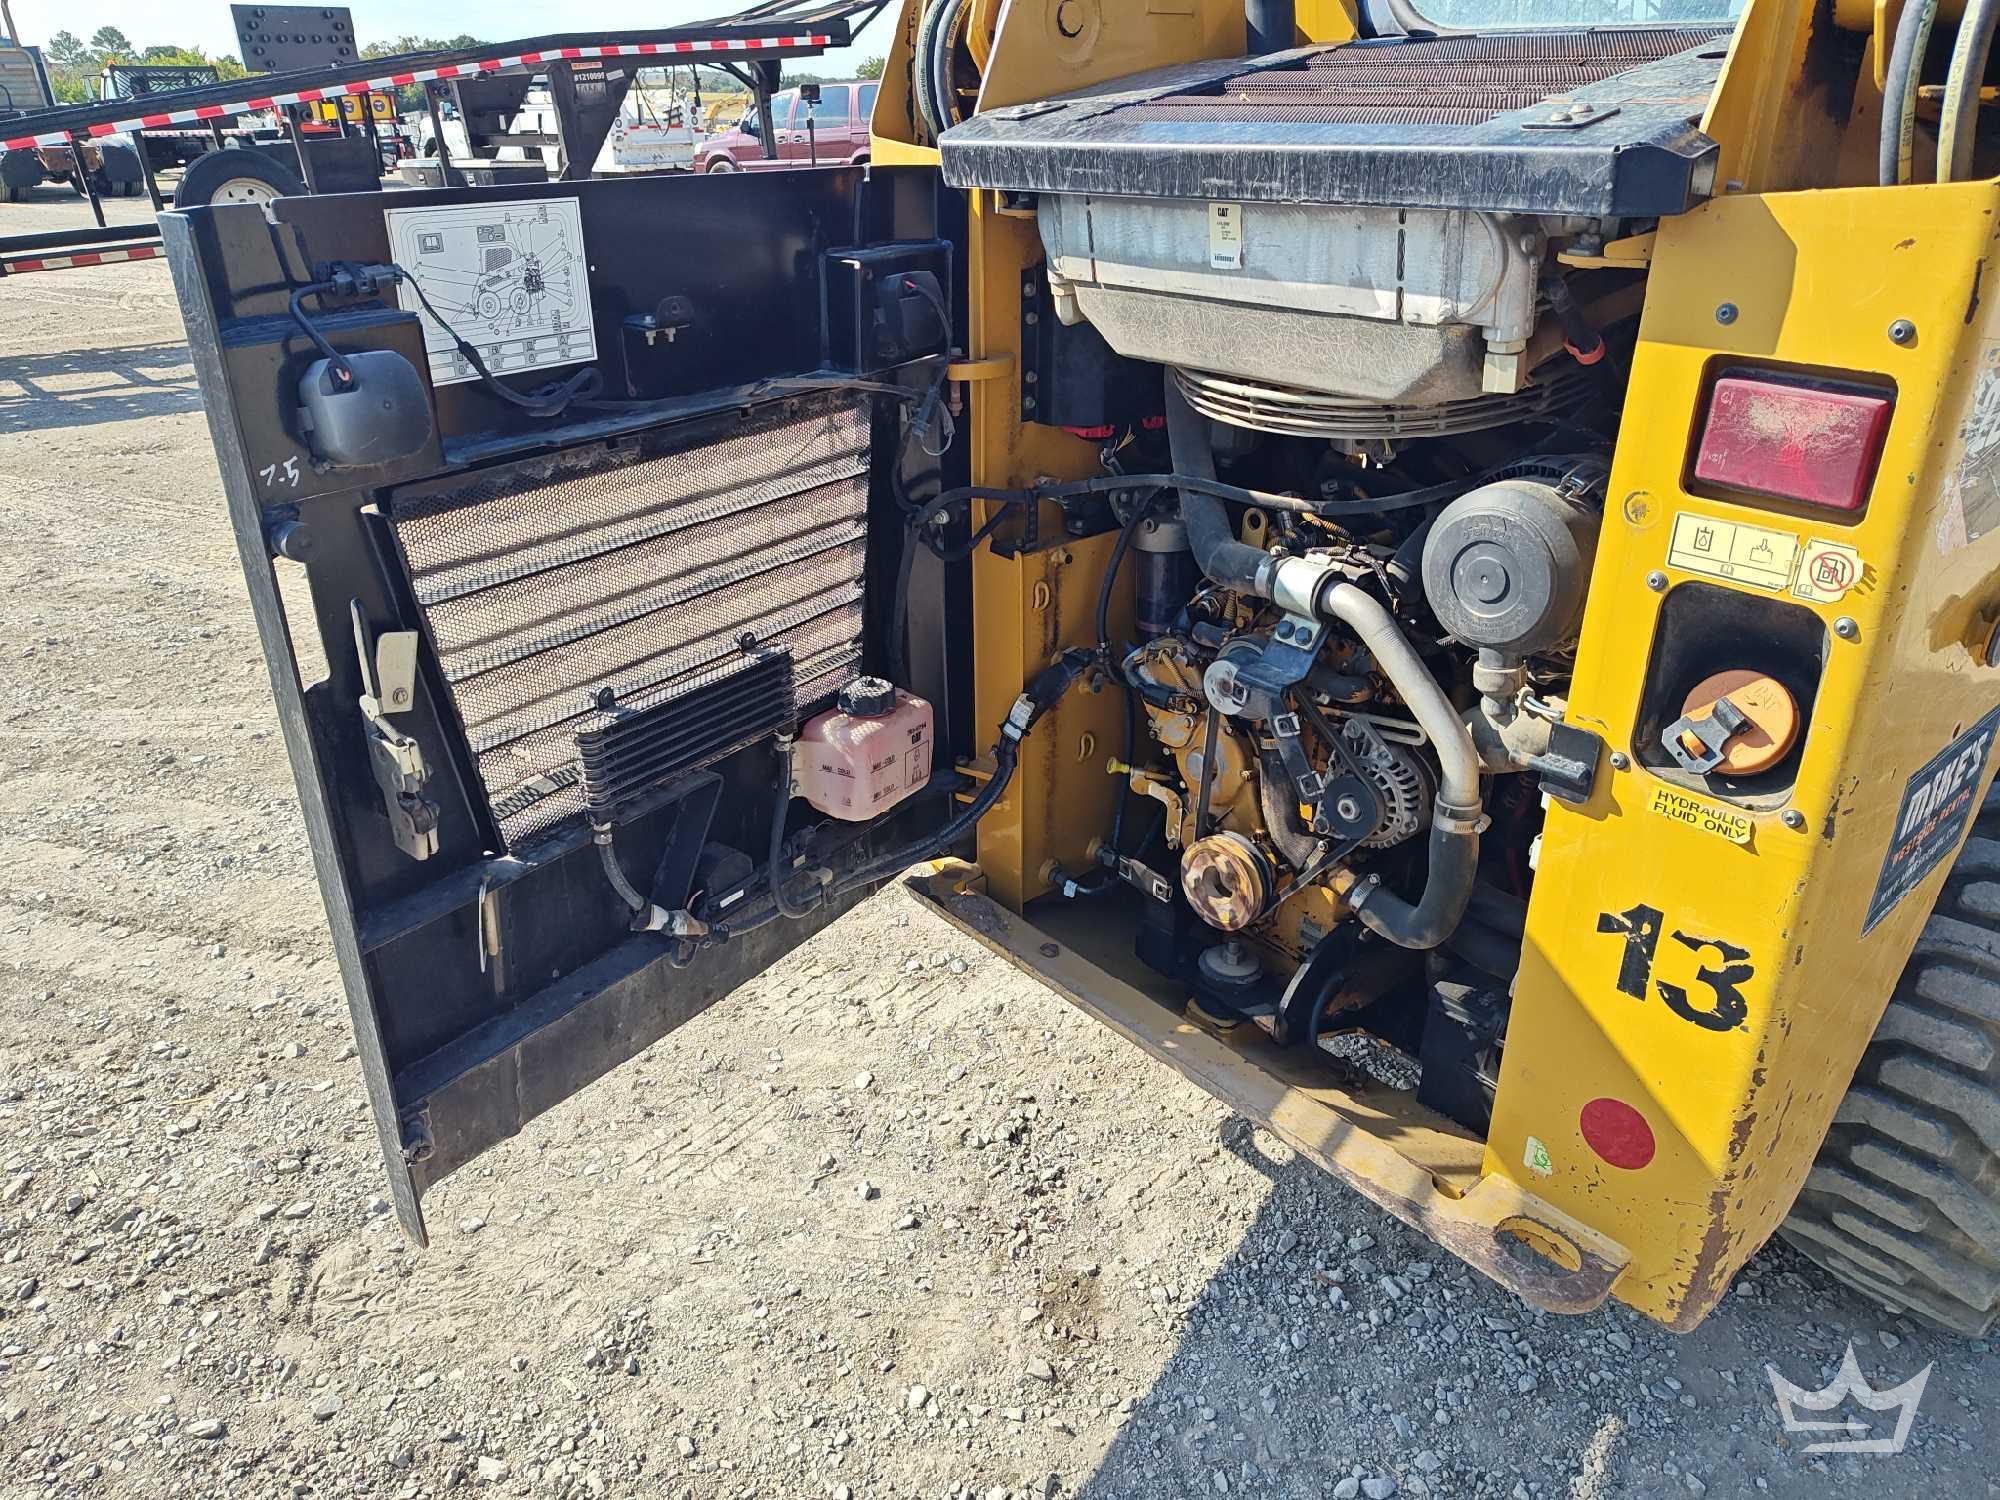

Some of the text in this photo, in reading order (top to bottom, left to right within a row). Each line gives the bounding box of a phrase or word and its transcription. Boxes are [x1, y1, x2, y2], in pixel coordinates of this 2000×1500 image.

[1217, 207, 1230, 217] CAT
[911, 730, 922, 745] CAT
[1653, 801, 1745, 840] FLUID ONLY
[1657, 789, 1748, 829] HYDRAULIC
[1596, 903, 1755, 1032] 13
